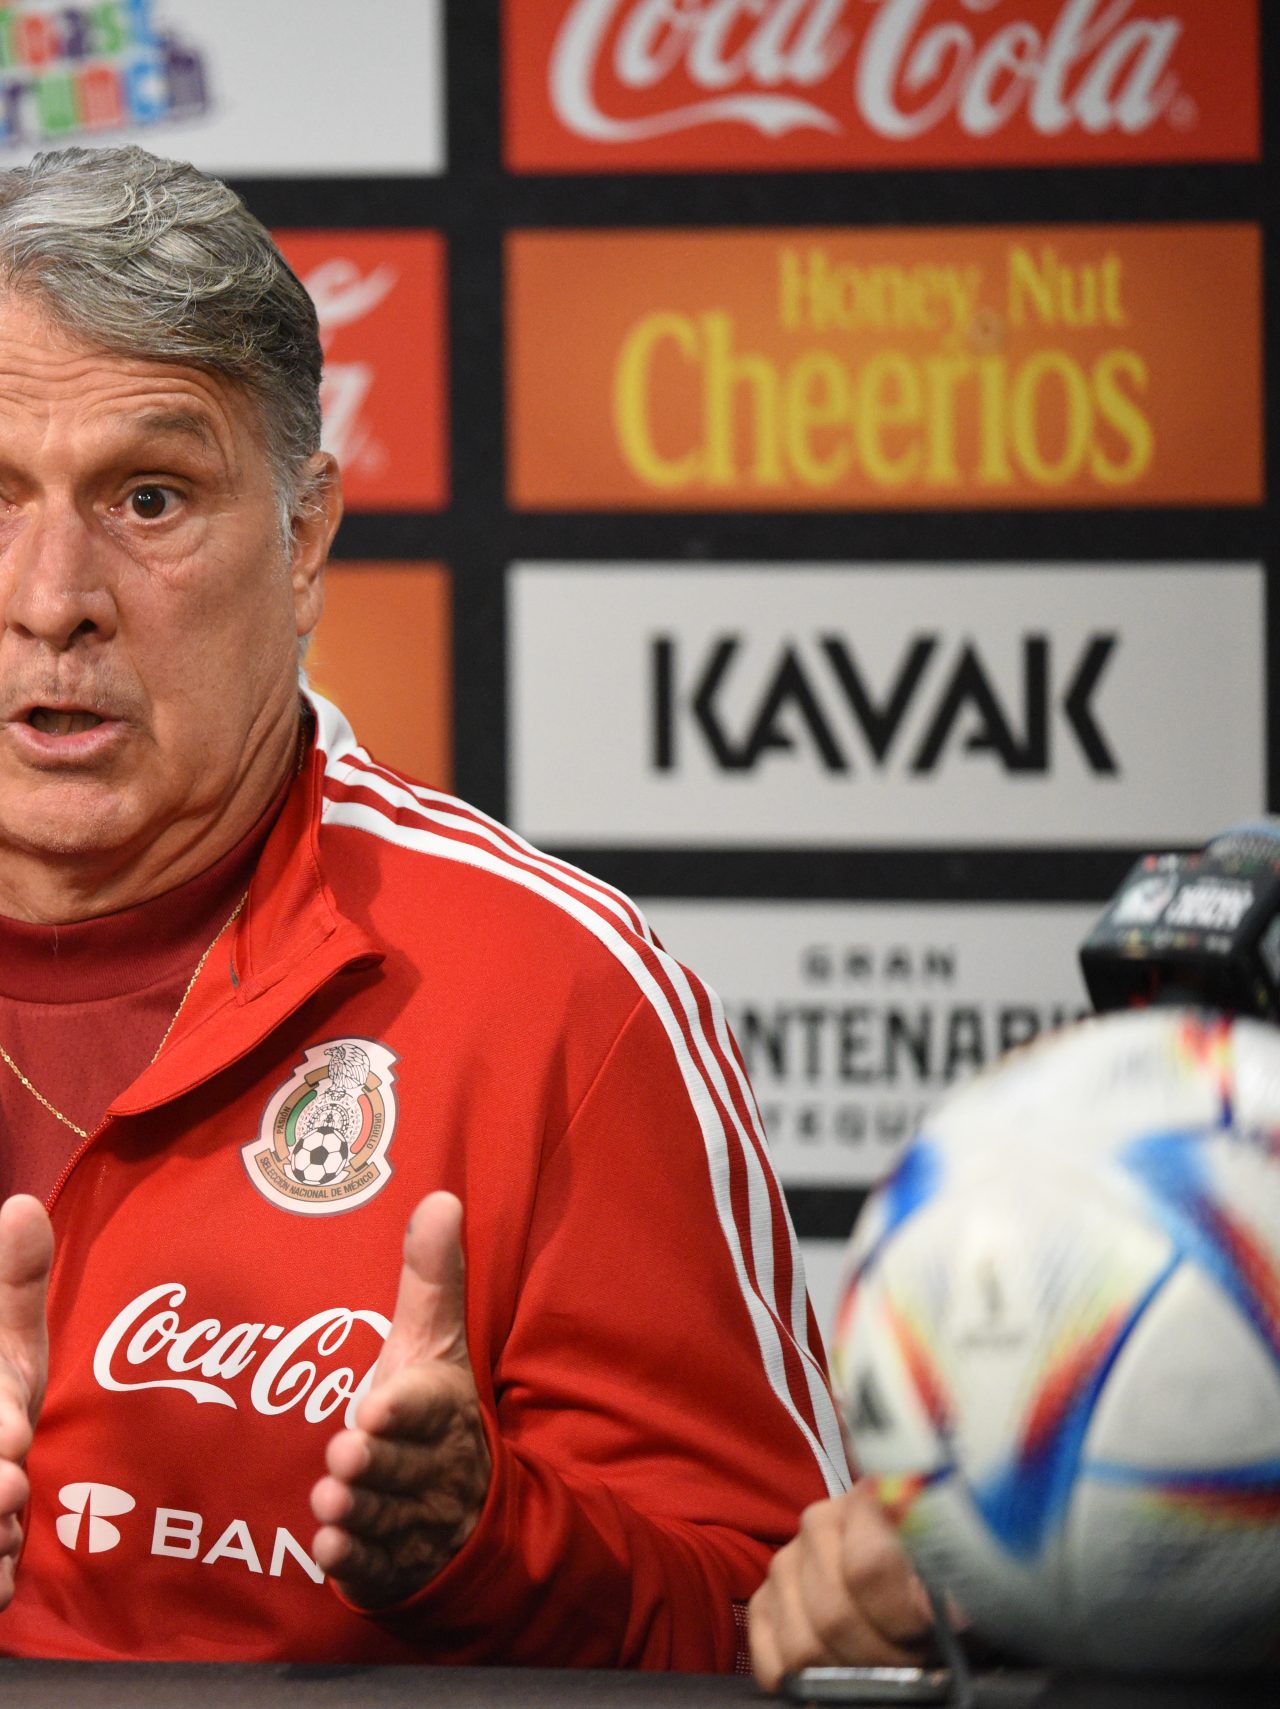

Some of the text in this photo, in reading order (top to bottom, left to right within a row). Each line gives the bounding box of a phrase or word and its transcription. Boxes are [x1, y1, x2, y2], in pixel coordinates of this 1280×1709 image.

[548, 0, 1188, 142] CocaCola
[778, 247, 1127, 354] Honey Nut
[613, 310, 1156, 488] Cheerios
[650, 632, 1122, 777] KAVAK
[800, 948, 958, 983] GRAN
[276, 1105, 291, 1135] PASIÓN
[367, 1112, 382, 1150] ORGULLO
[289, 1185, 329, 1199] NACIONAL
[331, 1186, 342, 1197] DE
[343, 1170, 375, 1195] MÉXICO
